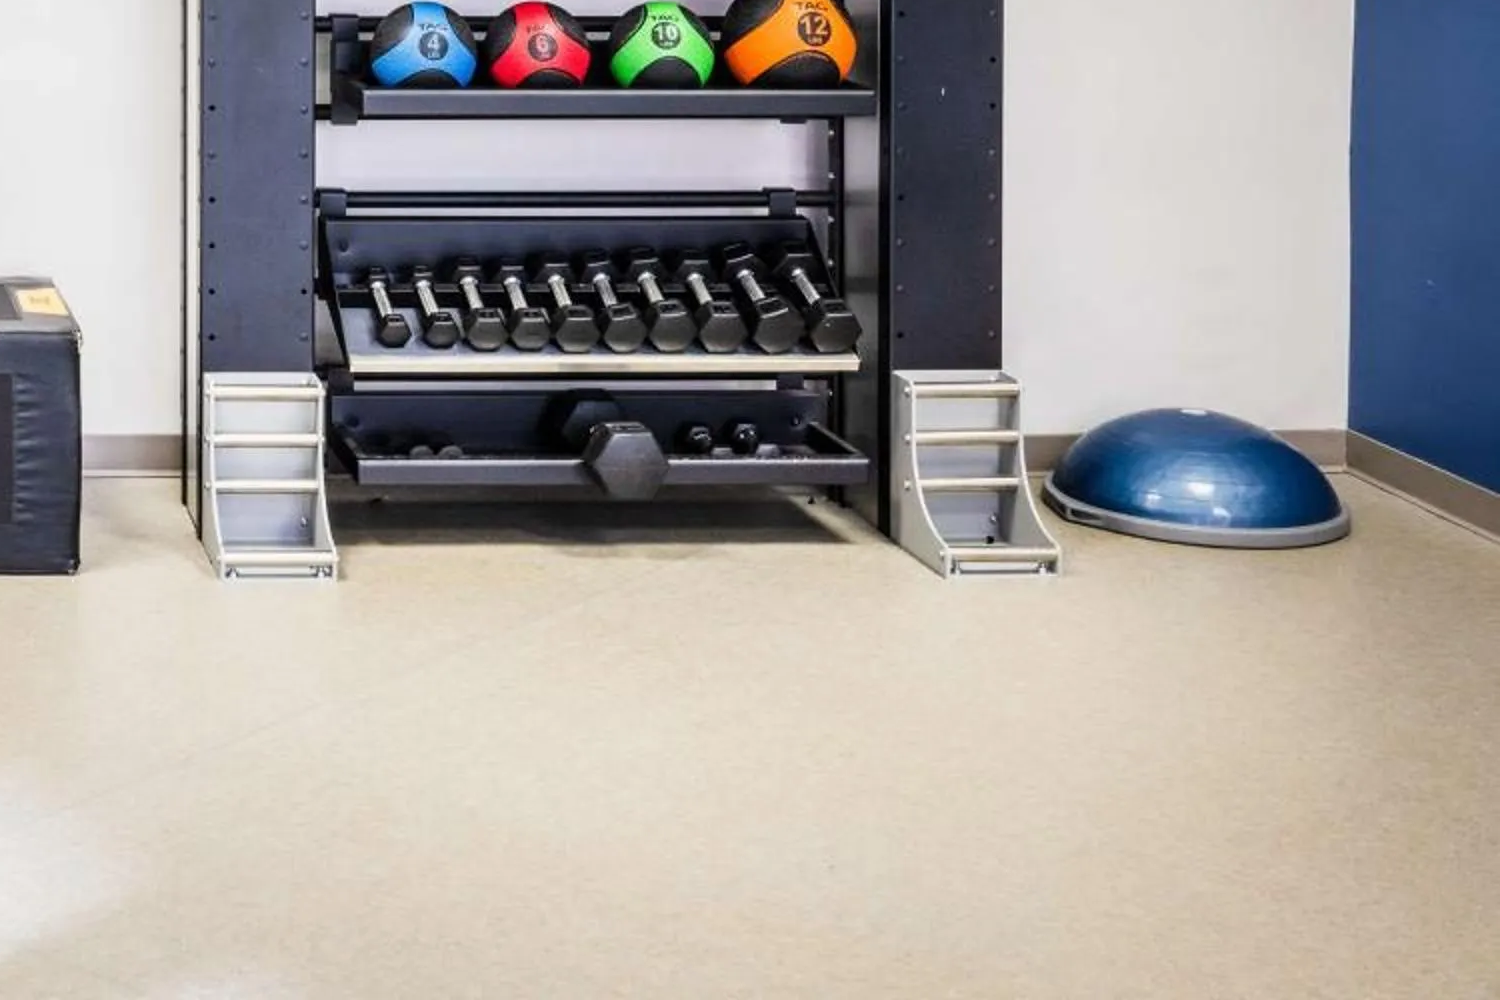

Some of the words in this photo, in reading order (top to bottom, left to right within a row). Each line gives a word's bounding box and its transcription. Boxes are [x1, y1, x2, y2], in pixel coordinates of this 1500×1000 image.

[792, 0, 829, 11] TAG
[654, 24, 678, 41] 10
[801, 16, 828, 35] 12
[427, 33, 440, 50] 4
[535, 34, 549, 53] 6
